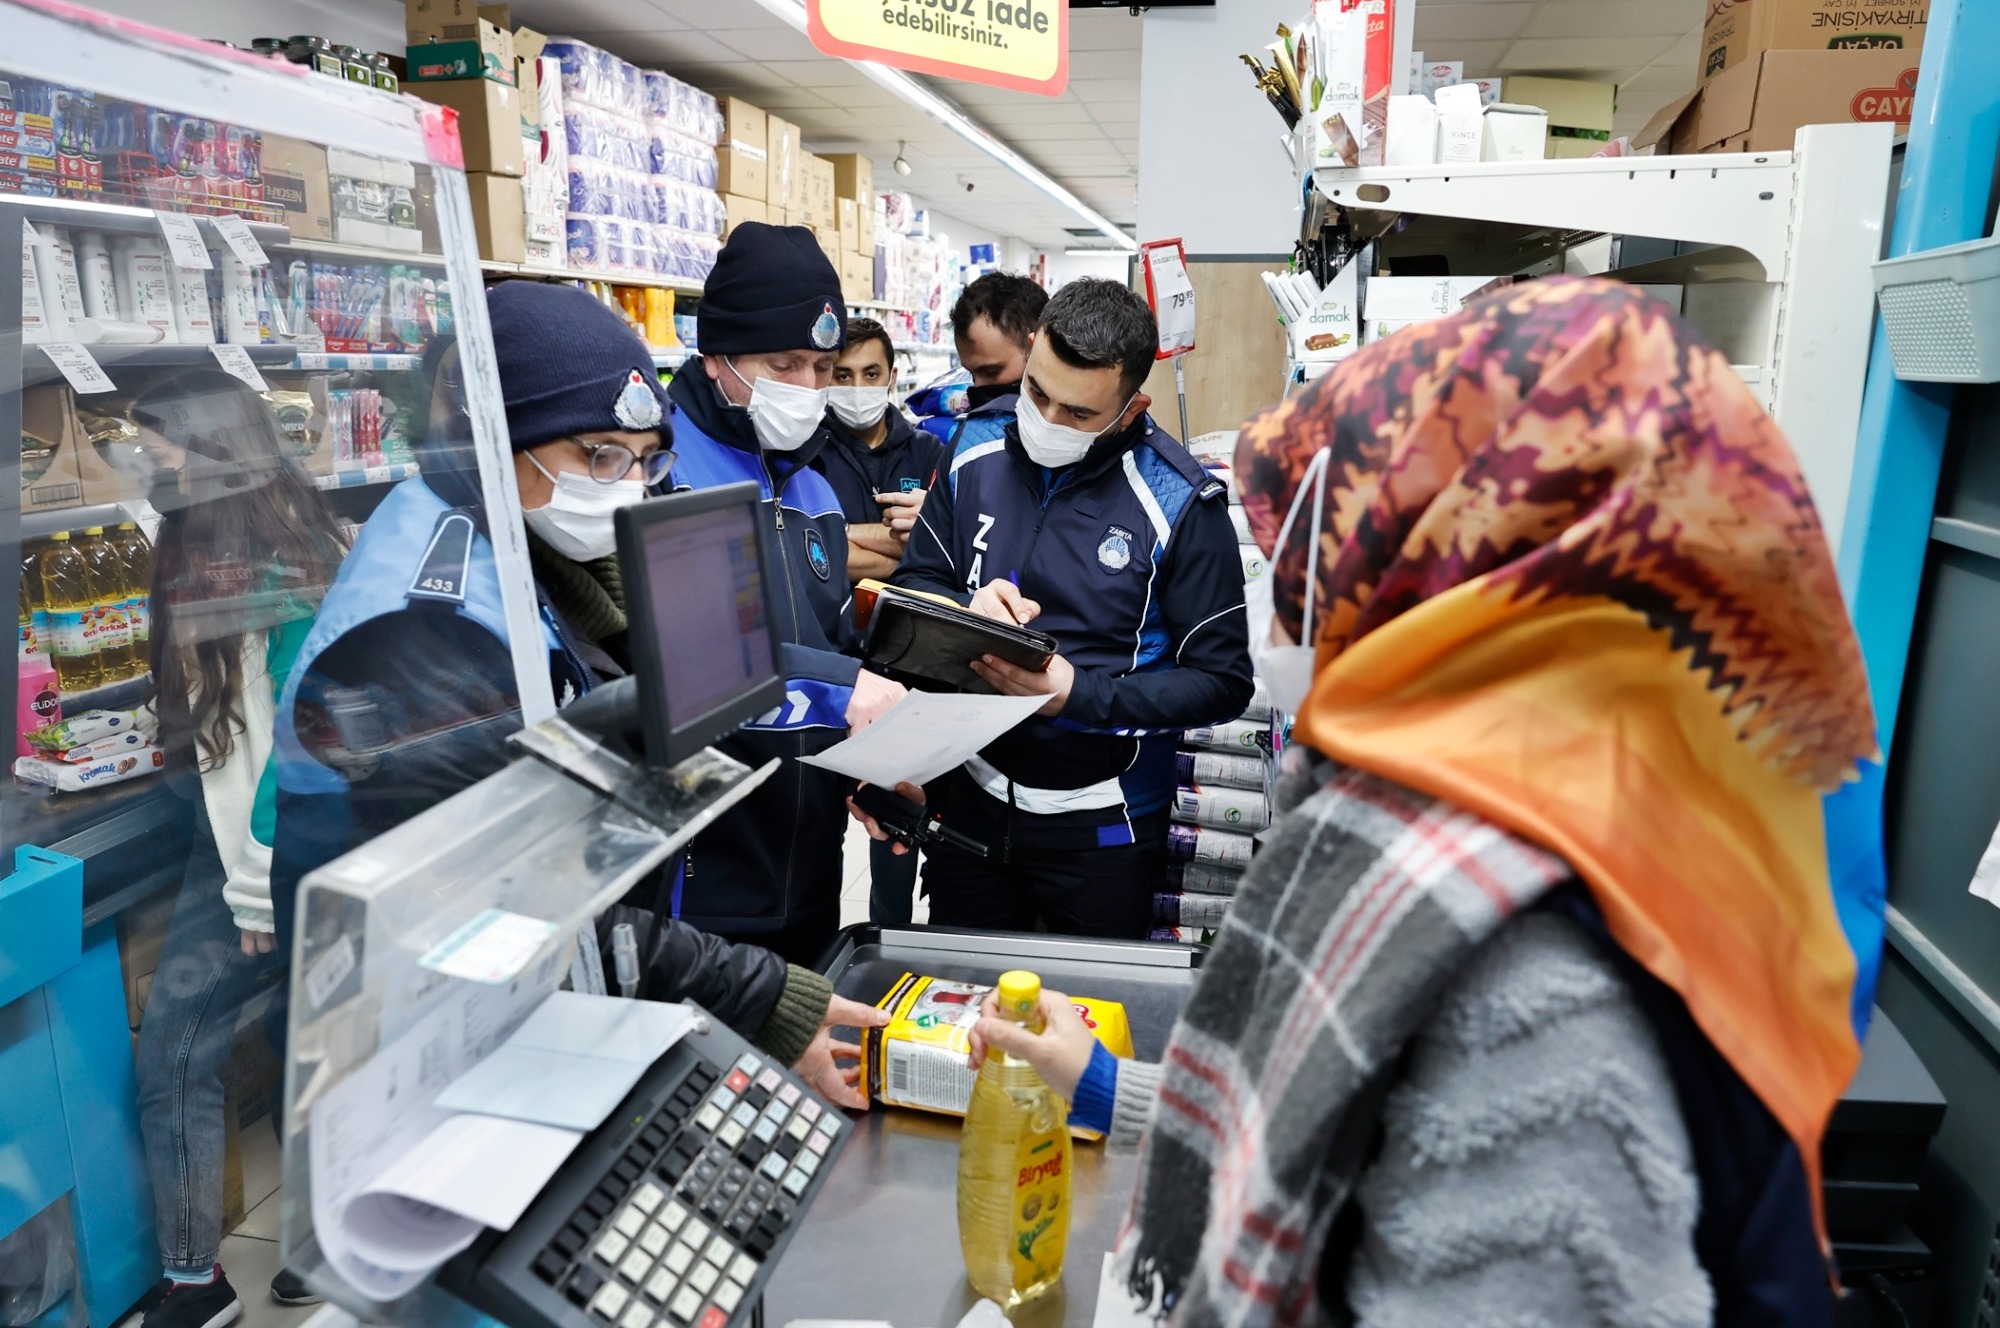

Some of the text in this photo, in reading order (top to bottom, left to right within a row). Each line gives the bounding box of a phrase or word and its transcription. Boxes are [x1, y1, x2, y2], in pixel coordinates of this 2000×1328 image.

[883, 4, 1008, 49] edebilirsiniz.
[1811, 10, 1927, 31] TİRYAKİSİNE
[1325, 86, 1360, 101] damak
[1440, 280, 1450, 314] damak
[1309, 305, 1350, 324] damak
[1109, 526, 1133, 541] ZABITA
[421, 578, 453, 592] 433
